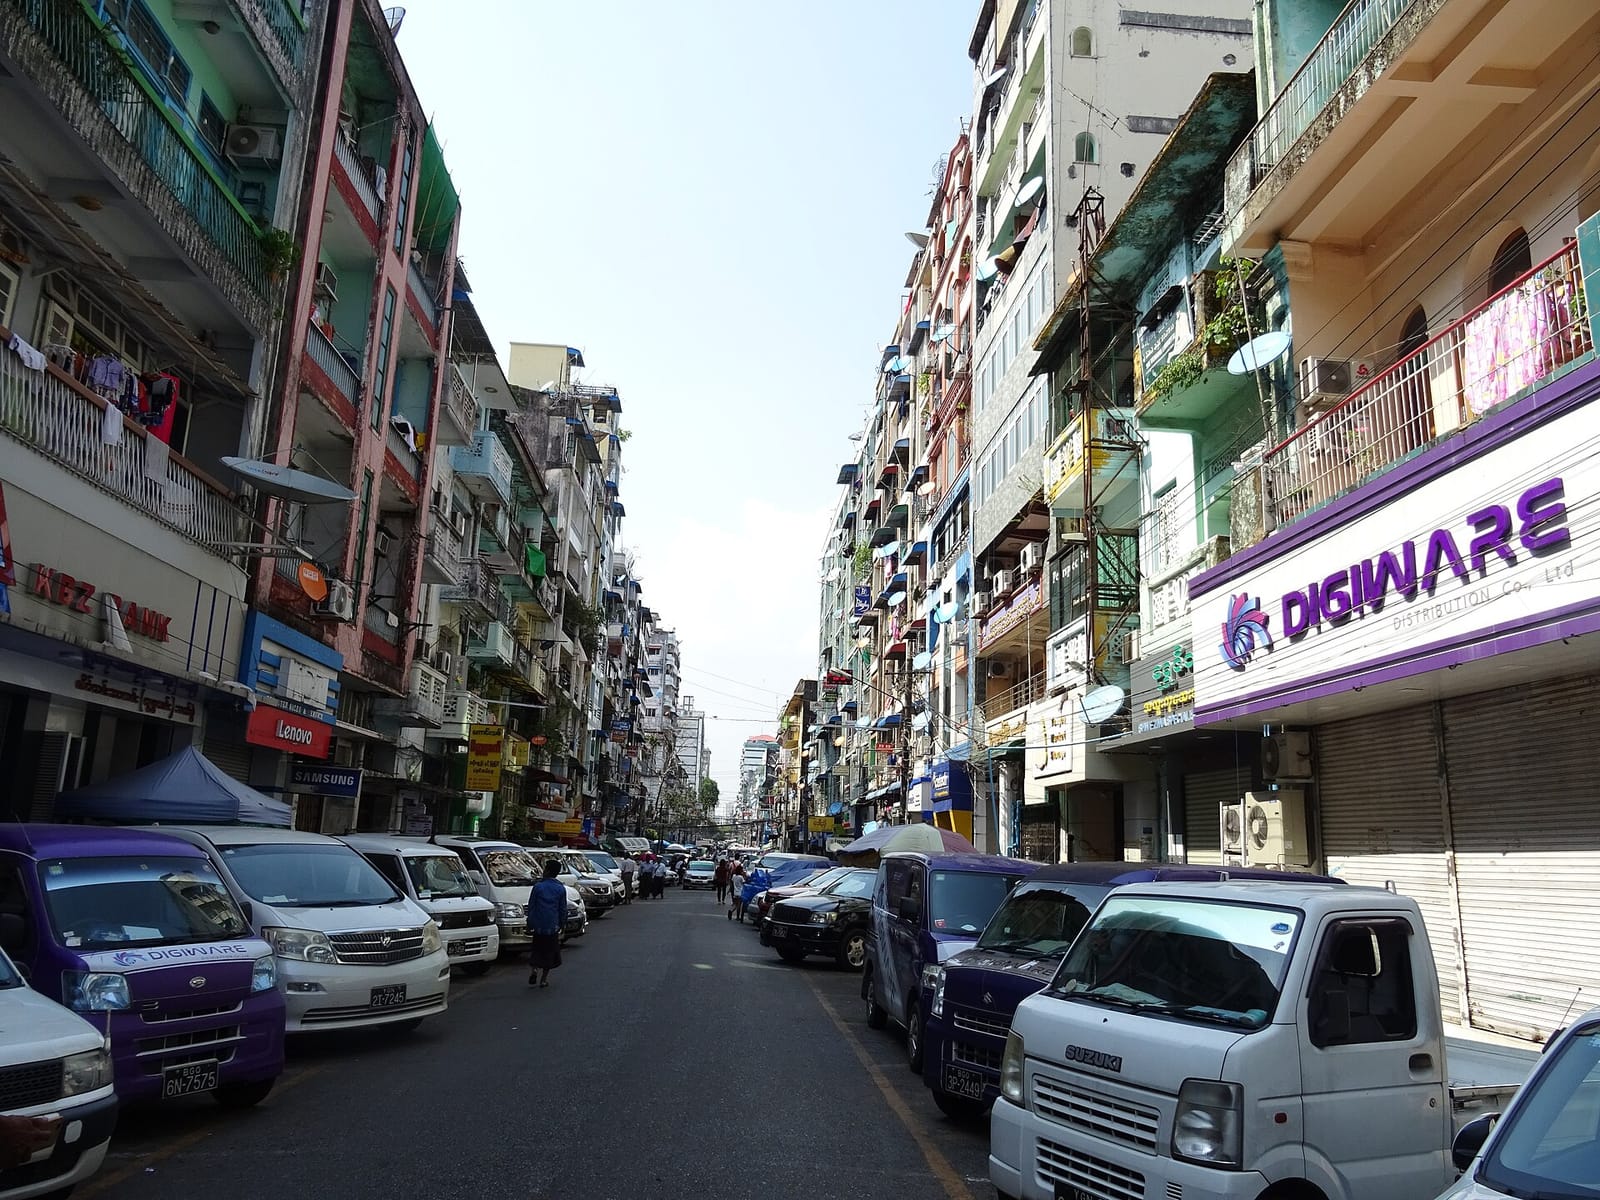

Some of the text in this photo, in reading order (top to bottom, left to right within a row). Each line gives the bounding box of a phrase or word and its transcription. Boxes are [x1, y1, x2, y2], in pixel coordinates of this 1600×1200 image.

[1281, 476, 1572, 638] DIGIWARE
[29, 563, 96, 615] KBZ
[1393, 587, 1490, 630] DISTRIBUTION
[1545, 559, 1574, 583] Ltd
[277, 719, 313, 745] Lenovo
[295, 770, 355, 786] SAMSUNG
[148, 944, 247, 960] DIGIWARE
[183, 1066, 201, 1076] BGO
[1065, 1044, 1123, 1074] SUZUKI
[166, 1071, 216, 1096] 6N-7575
